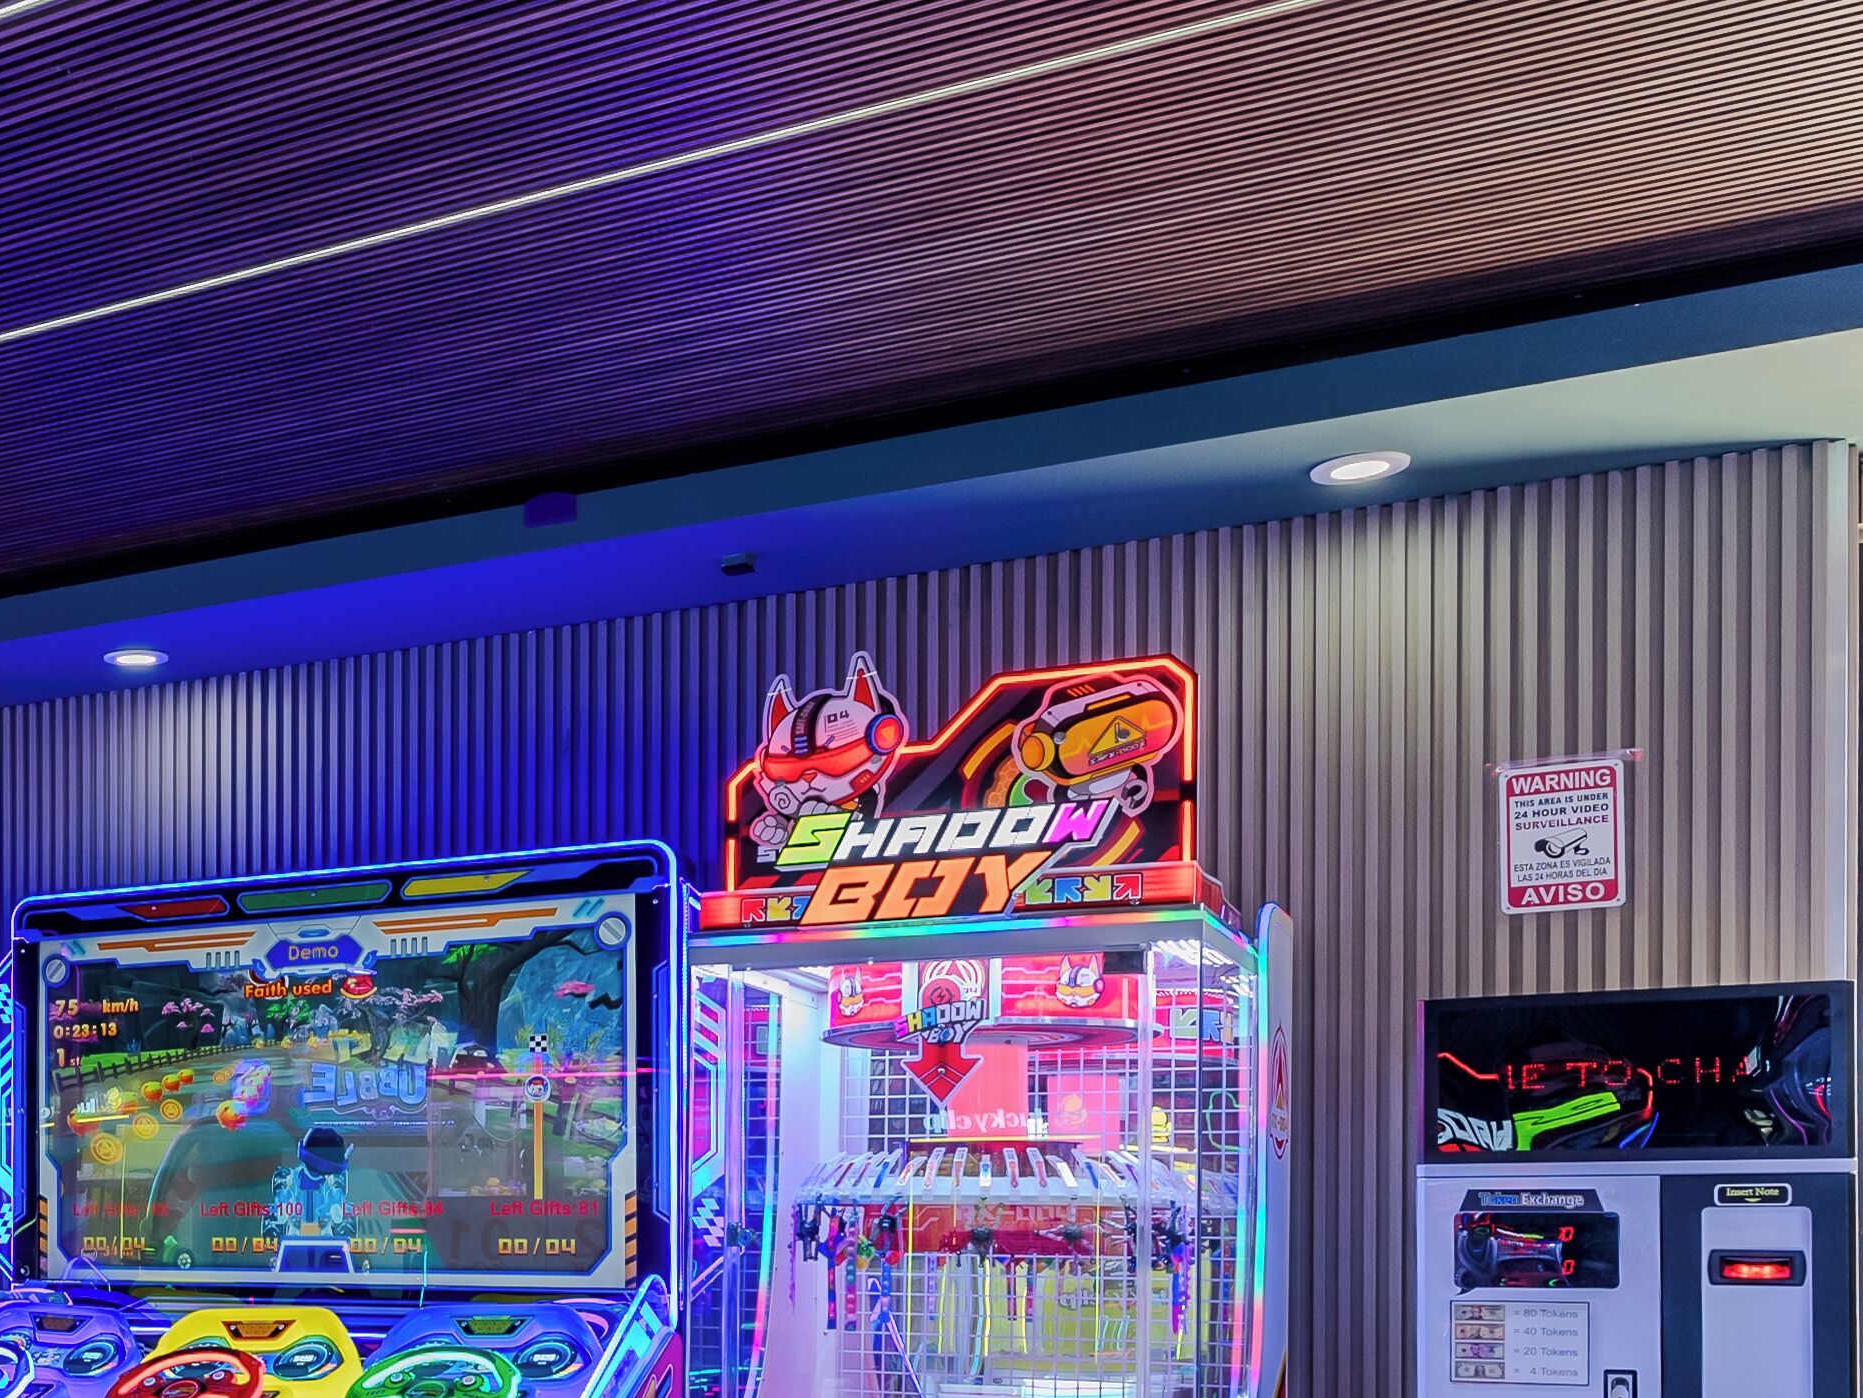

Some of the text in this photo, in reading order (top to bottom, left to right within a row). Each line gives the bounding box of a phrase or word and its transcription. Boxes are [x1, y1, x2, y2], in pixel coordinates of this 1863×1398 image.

[1512, 769, 1611, 795] WARNING
[1514, 792, 1609, 808] THIS AREA IS UNDER
[1514, 803, 1609, 820] 24 HOUR VIDEO
[1515, 814, 1609, 831] SURVEILLANCE
[775, 797, 1114, 869] SHADOW
[1514, 857, 1611, 873] ESTA ZONA ES VIGILADA
[1518, 873, 1533, 883] LAS
[1534, 872, 1544, 882] 24
[1545, 870, 1574, 880] HORAS
[1576, 868, 1592, 878] DEL
[798, 850, 1052, 926] BOY
[1521, 882, 1605, 906] AVISO
[287, 944, 339, 960] Demo
[244, 979, 333, 999] Faith used
[55, 997, 139, 1017] 75 km/h
[894, 999, 984, 1039] SHADOW
[927, 1019, 976, 1044] BOY
[1479, 1191, 1585, 1209] Token Exchange
[1725, 1187, 1780, 1197] Insert Note
[200, 1202, 230, 1217] Left
[490, 1202, 524, 1216] Left
[1539, 1308, 1579, 1319] Tokens
[1522, 1327, 1579, 1338] 40 Tokens
[1522, 1346, 1579, 1357] 20 Tokens
[1529, 1366, 1579, 1377] 4 Tokens
